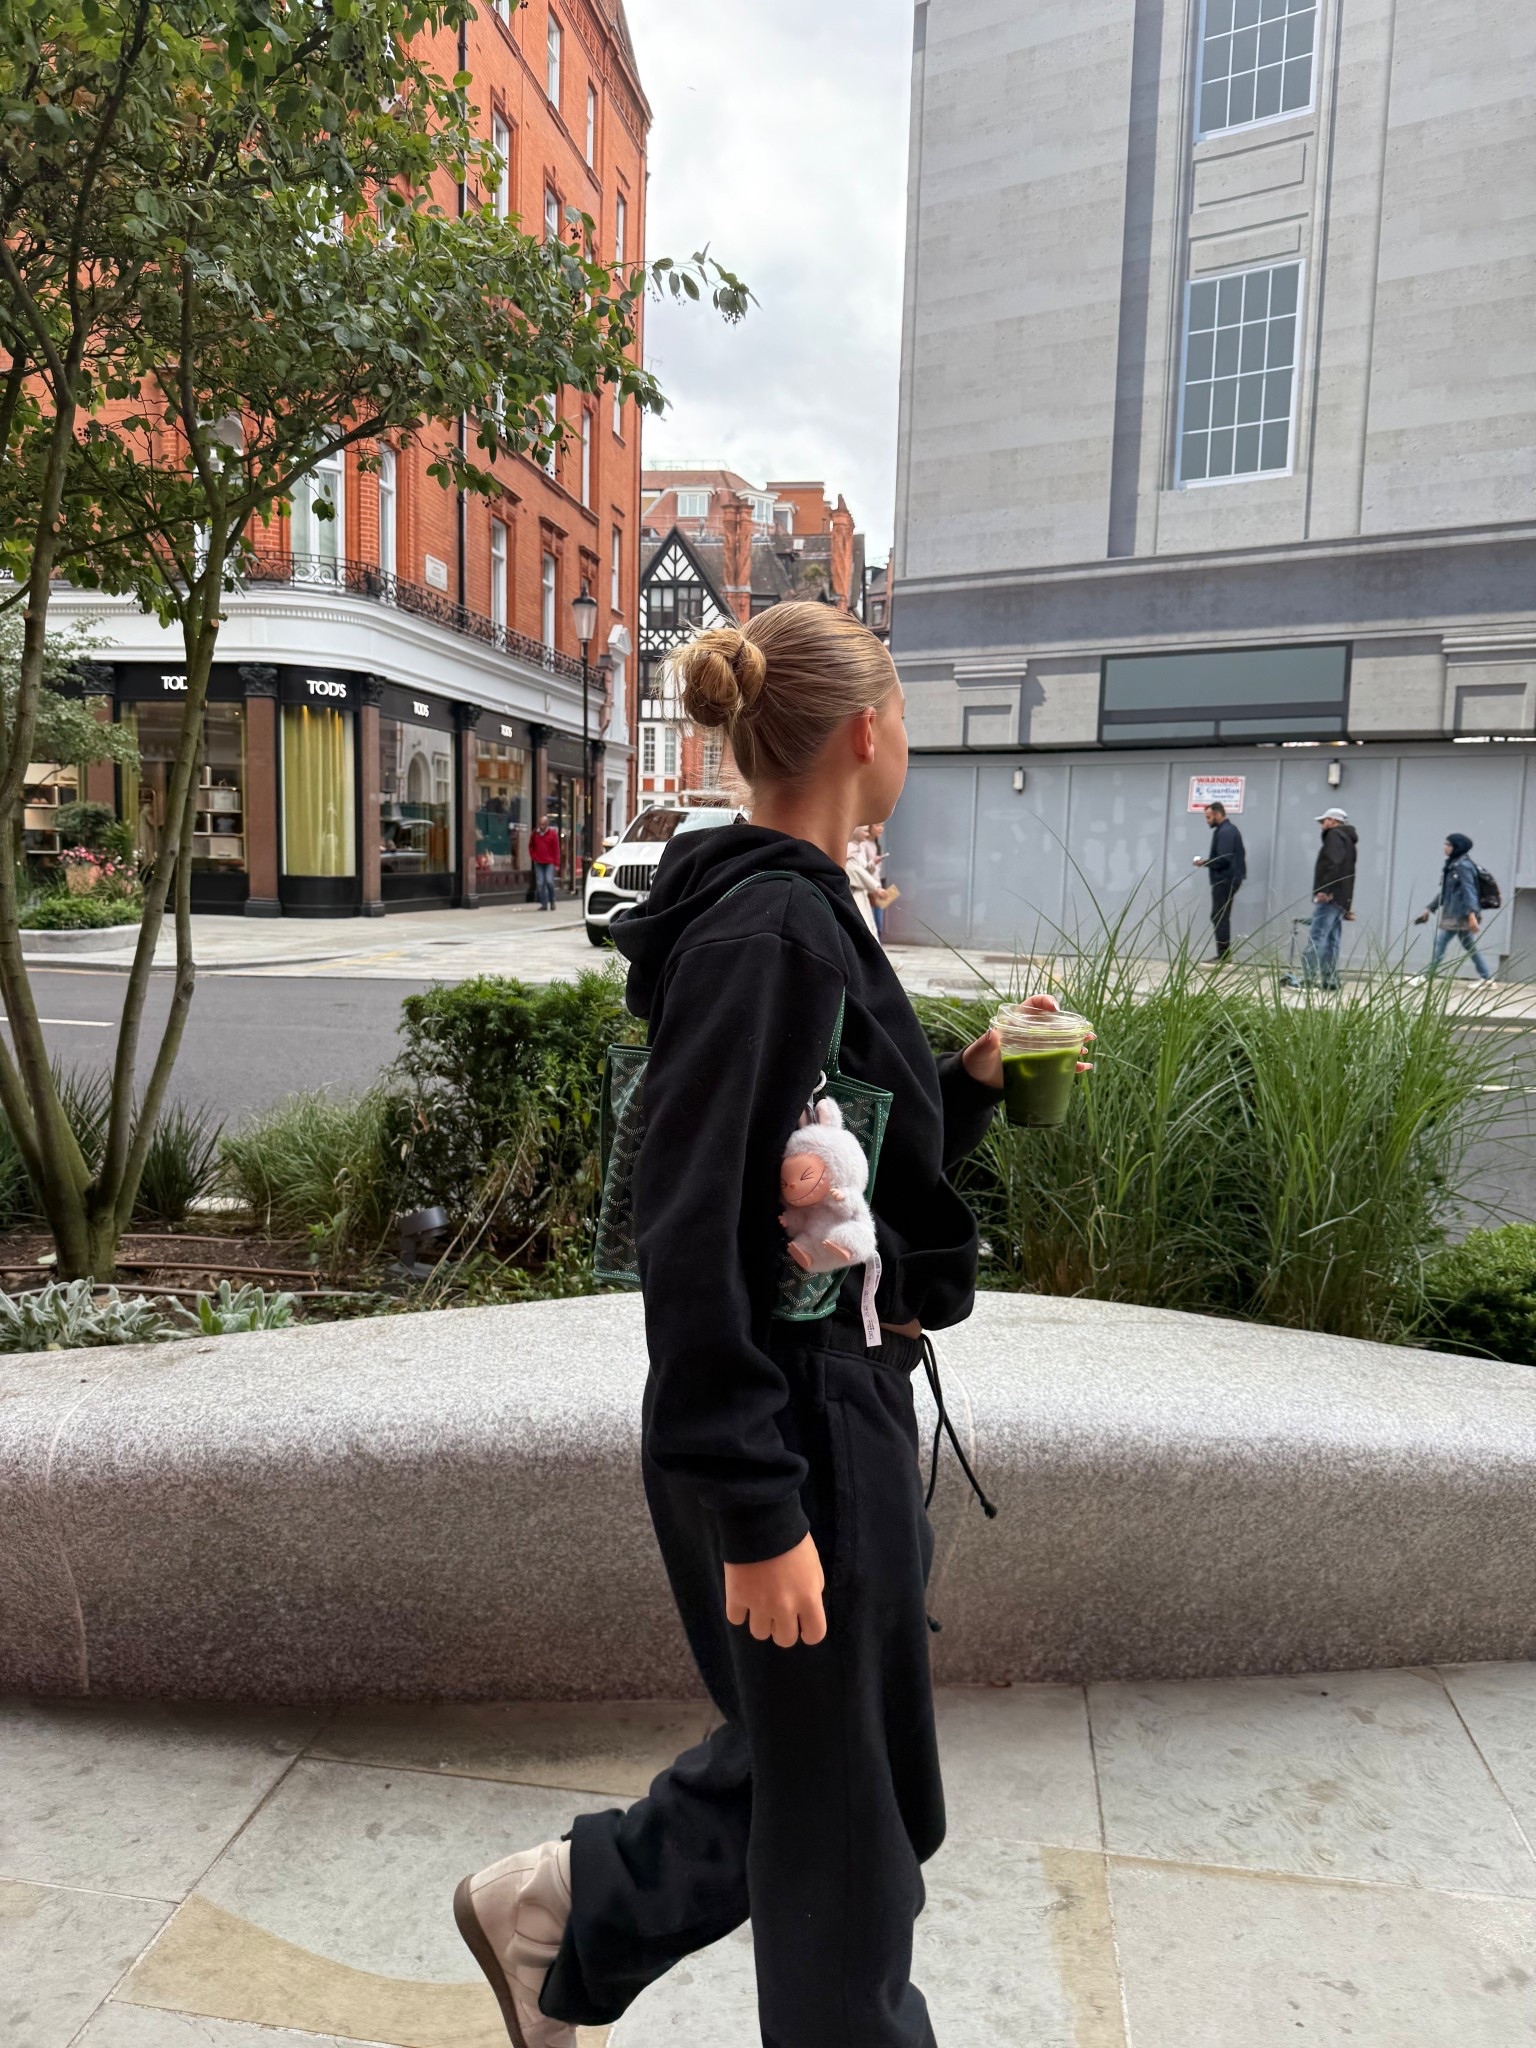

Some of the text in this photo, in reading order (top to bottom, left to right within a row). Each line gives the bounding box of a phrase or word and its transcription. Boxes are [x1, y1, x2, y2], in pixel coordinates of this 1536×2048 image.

[161, 675, 188, 690] TOD
[306, 680, 347, 698] TOD'S
[501, 724, 513, 738] TODS
